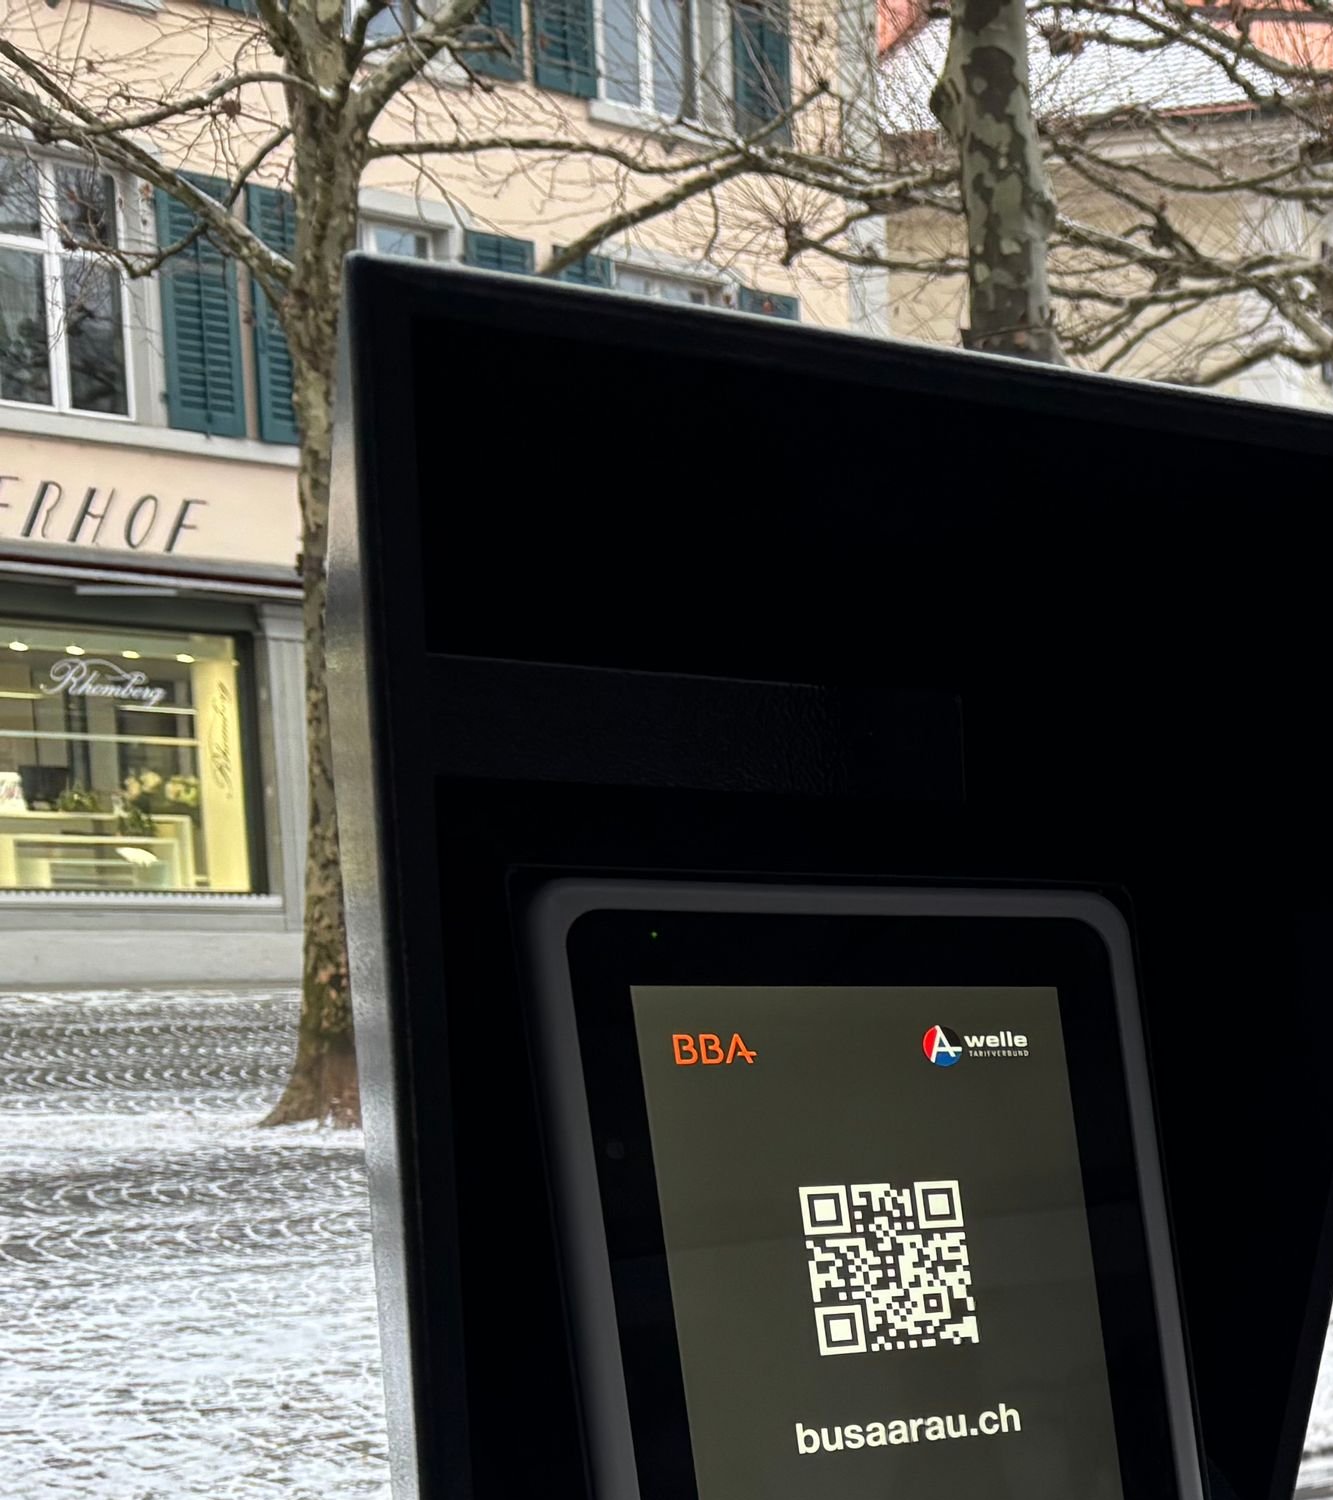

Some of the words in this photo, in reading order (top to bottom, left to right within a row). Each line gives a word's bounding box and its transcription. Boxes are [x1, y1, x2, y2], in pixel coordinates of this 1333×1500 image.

[40, 658, 167, 709] Rhomberg
[672, 1033, 757, 1065] BBA
[963, 1030, 1029, 1049] welle
[968, 1049, 1030, 1058] TARIFVERBUND
[795, 1403, 1022, 1455] busaarau.ch
